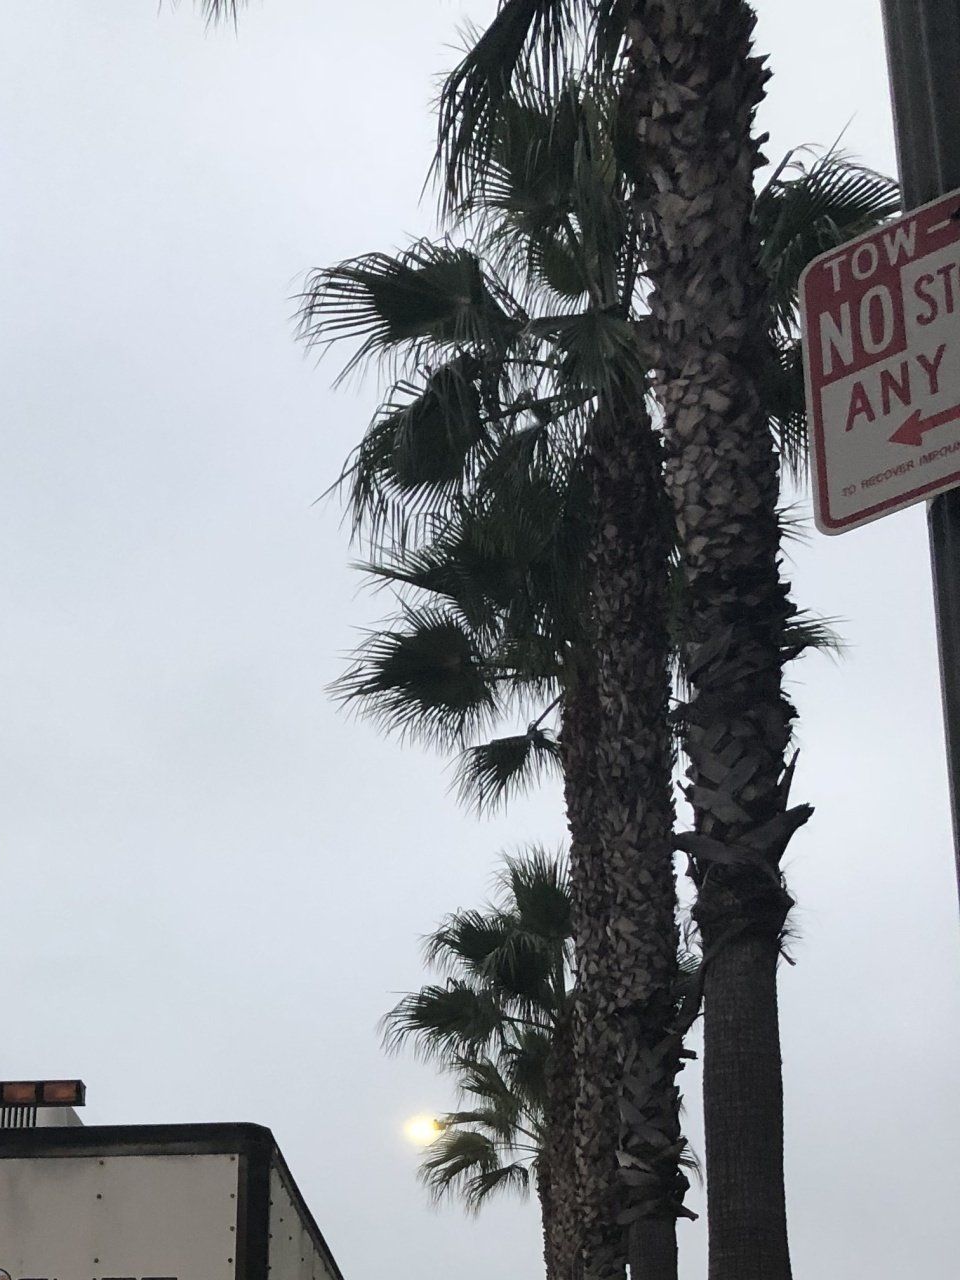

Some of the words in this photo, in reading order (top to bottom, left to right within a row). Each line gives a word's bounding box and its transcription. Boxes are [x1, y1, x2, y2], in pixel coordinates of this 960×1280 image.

[819, 284, 895, 376] NO
[914, 262, 960, 326] ST
[845, 344, 948, 431] ANY
[842, 484, 857, 497] TO
[861, 460, 915, 490] RECOVER
